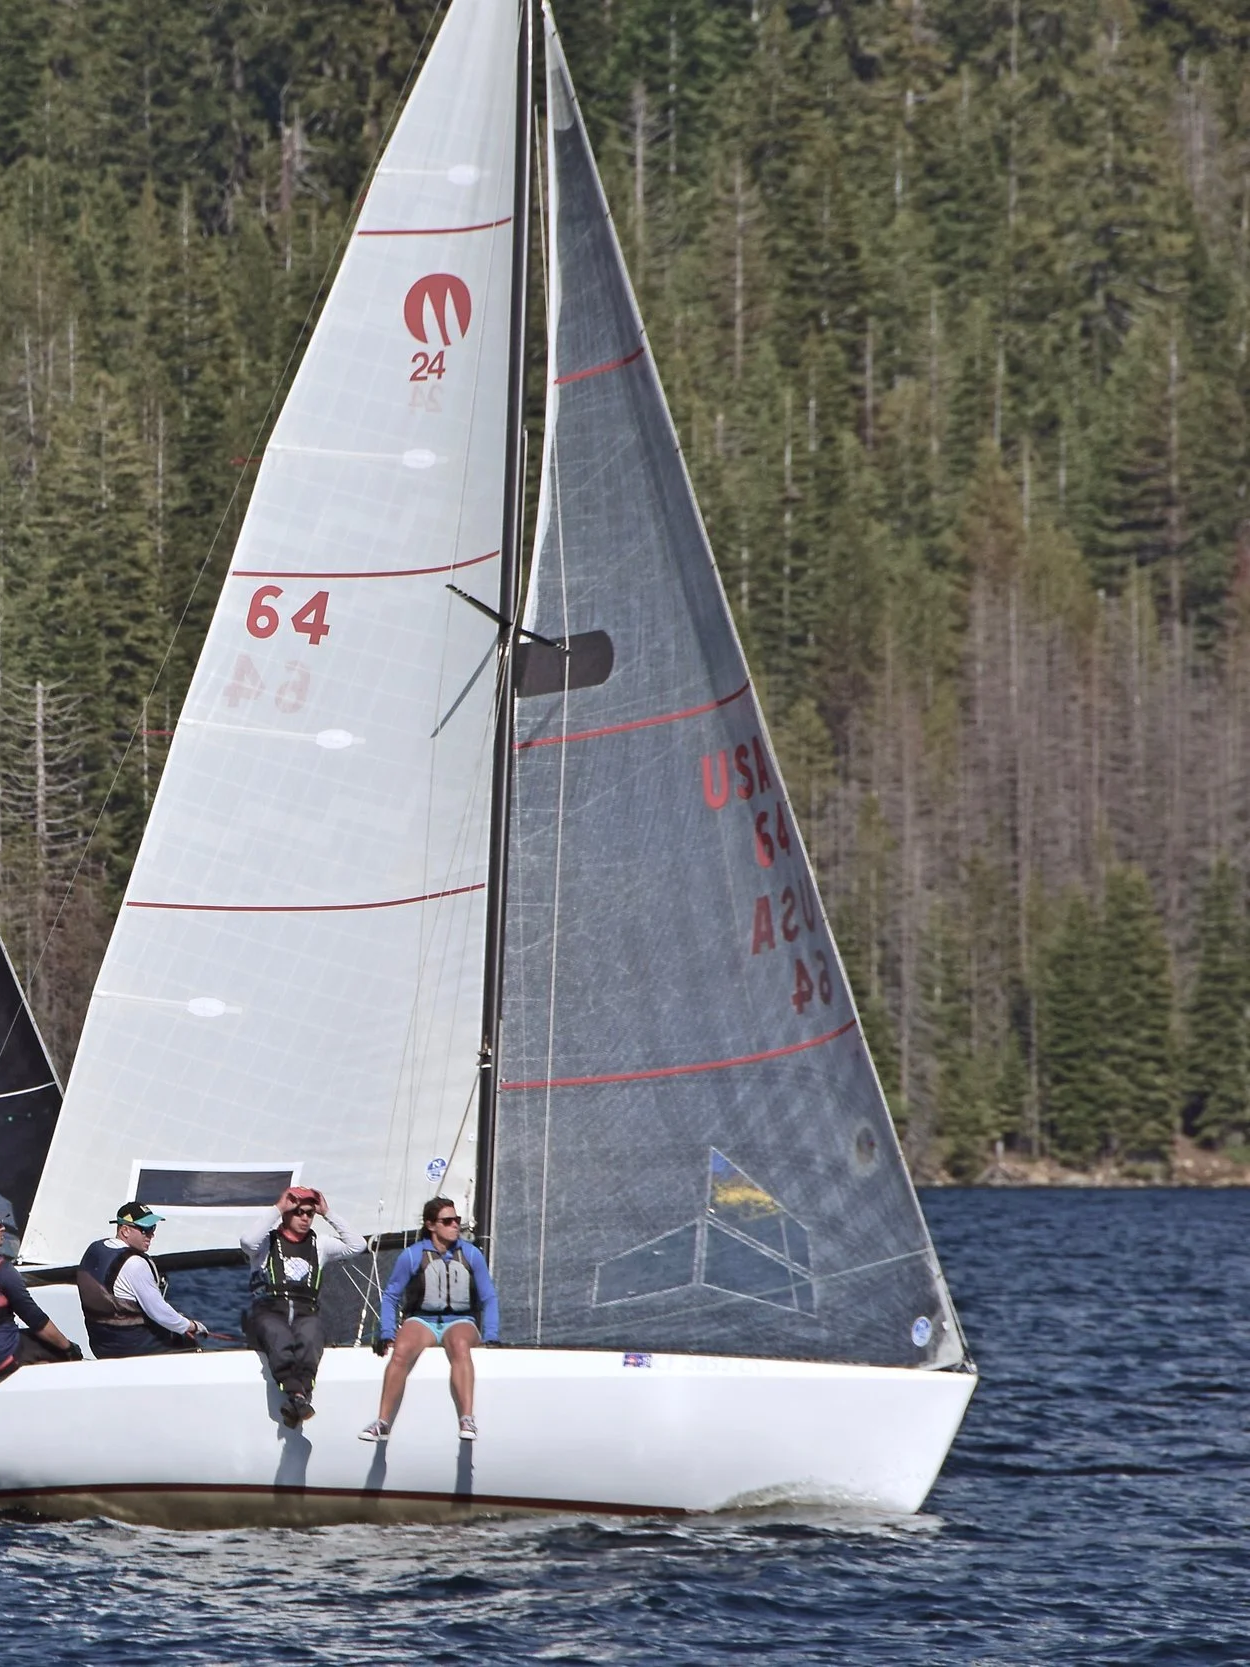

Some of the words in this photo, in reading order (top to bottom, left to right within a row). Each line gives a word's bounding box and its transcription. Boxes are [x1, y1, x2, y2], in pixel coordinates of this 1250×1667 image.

[409, 350, 446, 381] 24
[246, 585, 331, 645] 64
[701, 735, 772, 811] USA
[754, 801, 791, 868] 64
